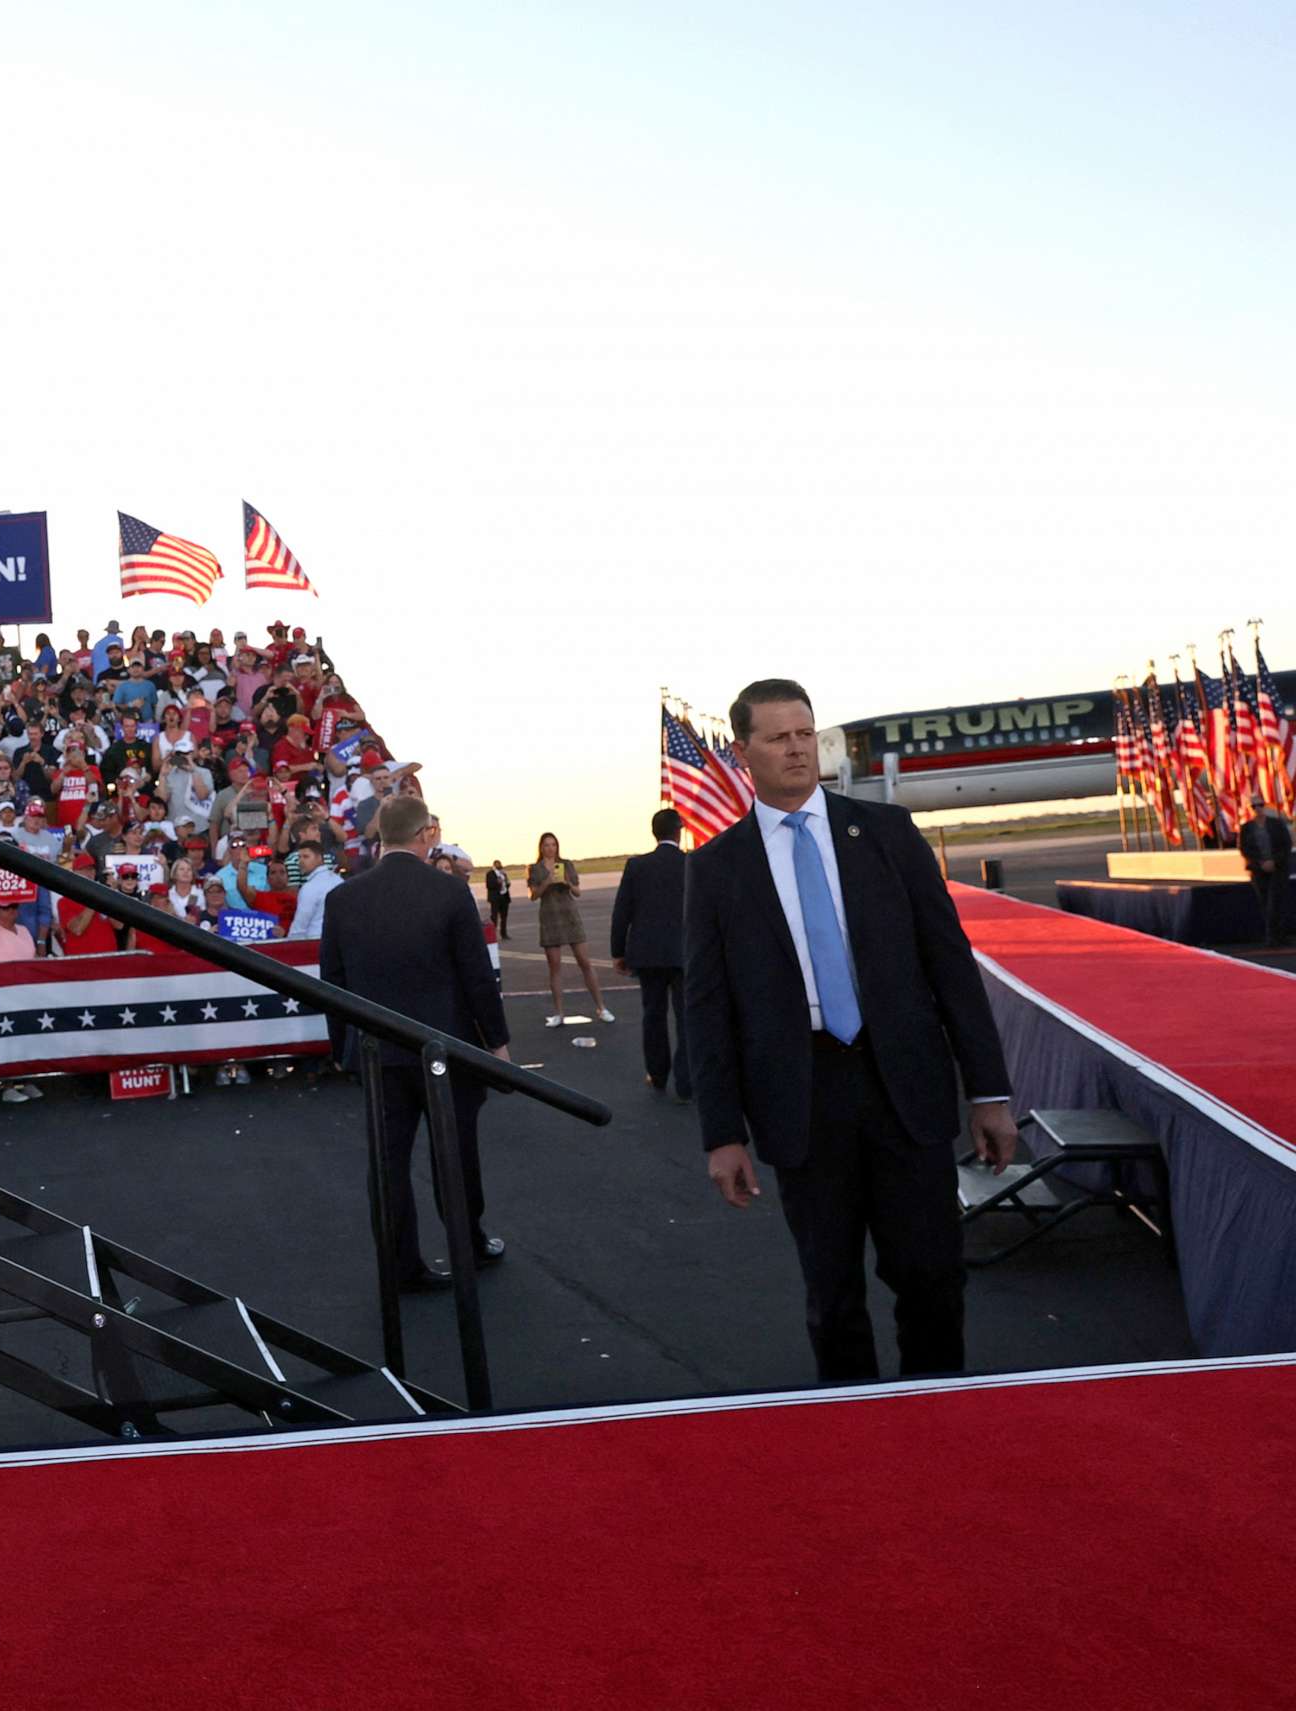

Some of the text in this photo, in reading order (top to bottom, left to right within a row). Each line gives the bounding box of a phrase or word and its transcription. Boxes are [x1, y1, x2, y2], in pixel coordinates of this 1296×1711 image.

[875, 700, 1095, 743] TRUMP
[224, 916, 275, 931] TRUMP
[231, 926, 268, 940] 2024
[121, 1074, 162, 1089] HUNT
